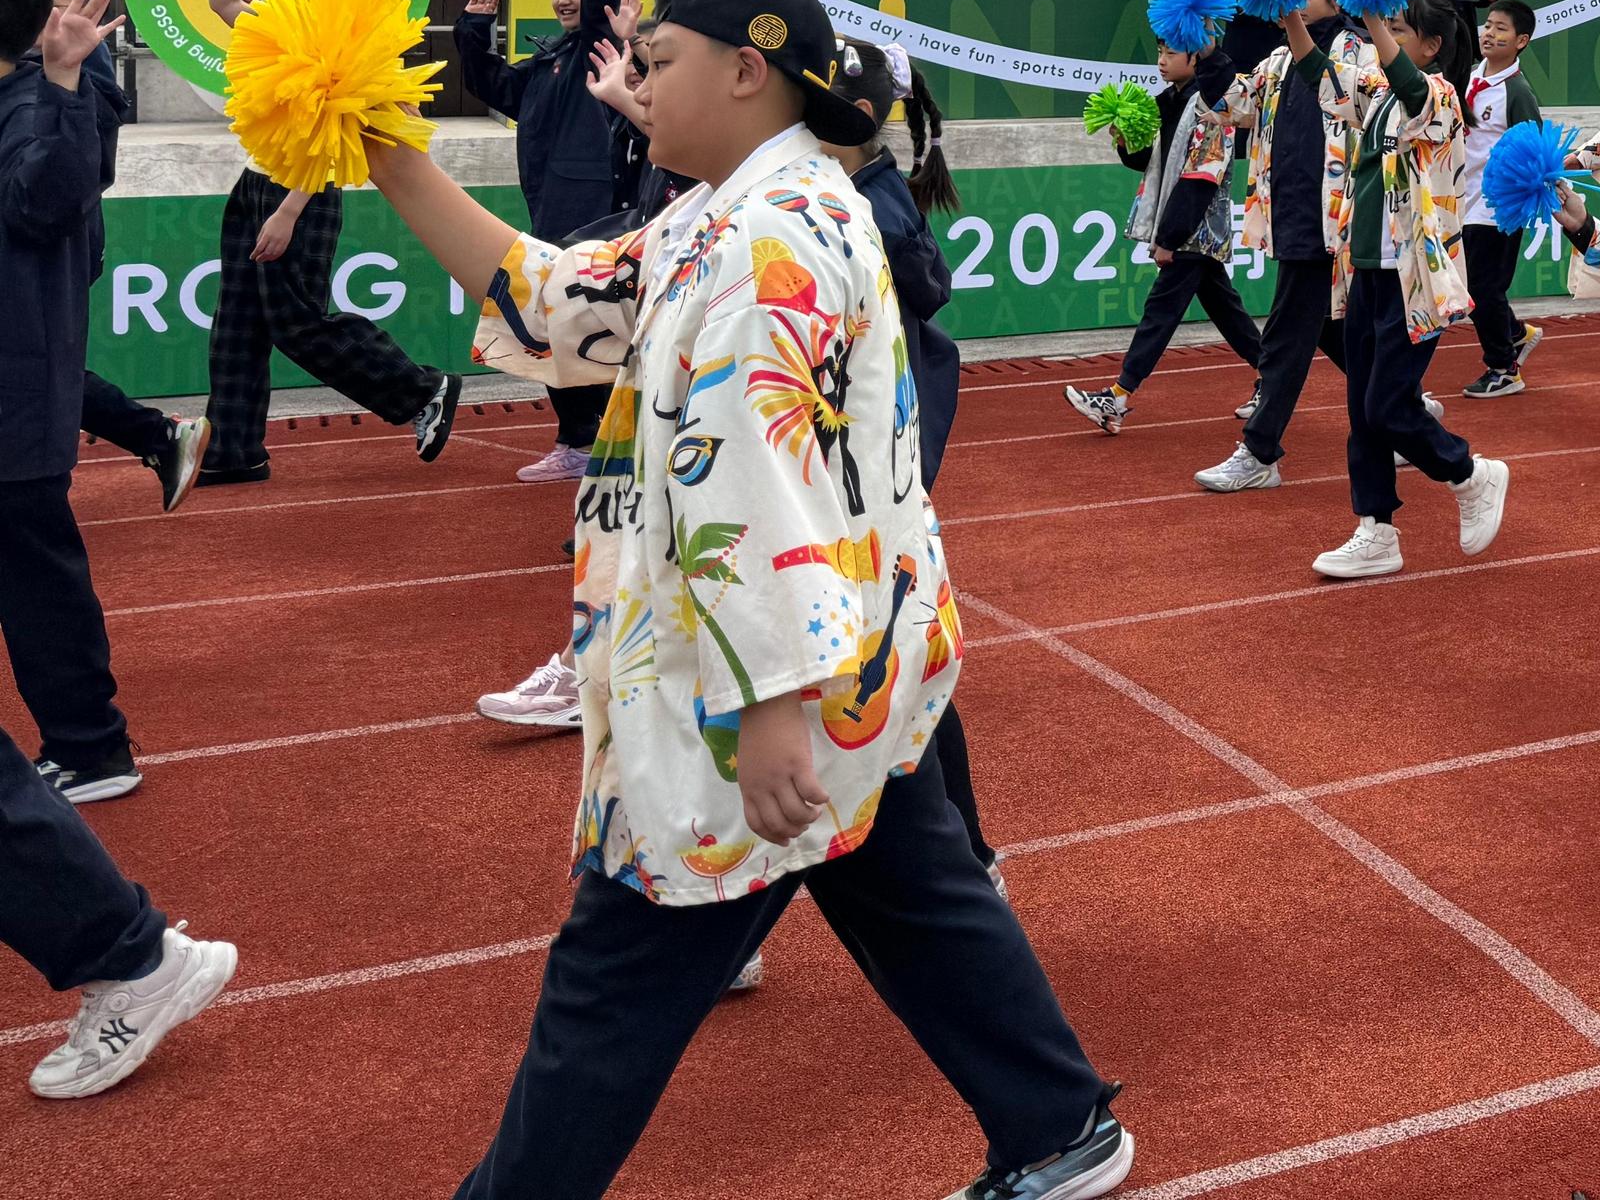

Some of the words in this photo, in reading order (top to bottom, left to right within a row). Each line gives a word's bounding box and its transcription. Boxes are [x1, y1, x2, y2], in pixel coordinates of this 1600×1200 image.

[151, 4, 188, 48] RGSG
[1545, 3, 1586, 25] sports
[870, 20, 902, 40] day
[919, 34, 961, 56] have
[969, 47, 995, 64] fun
[1012, 60, 1065, 77] sports
[1072, 67, 1103, 85] day
